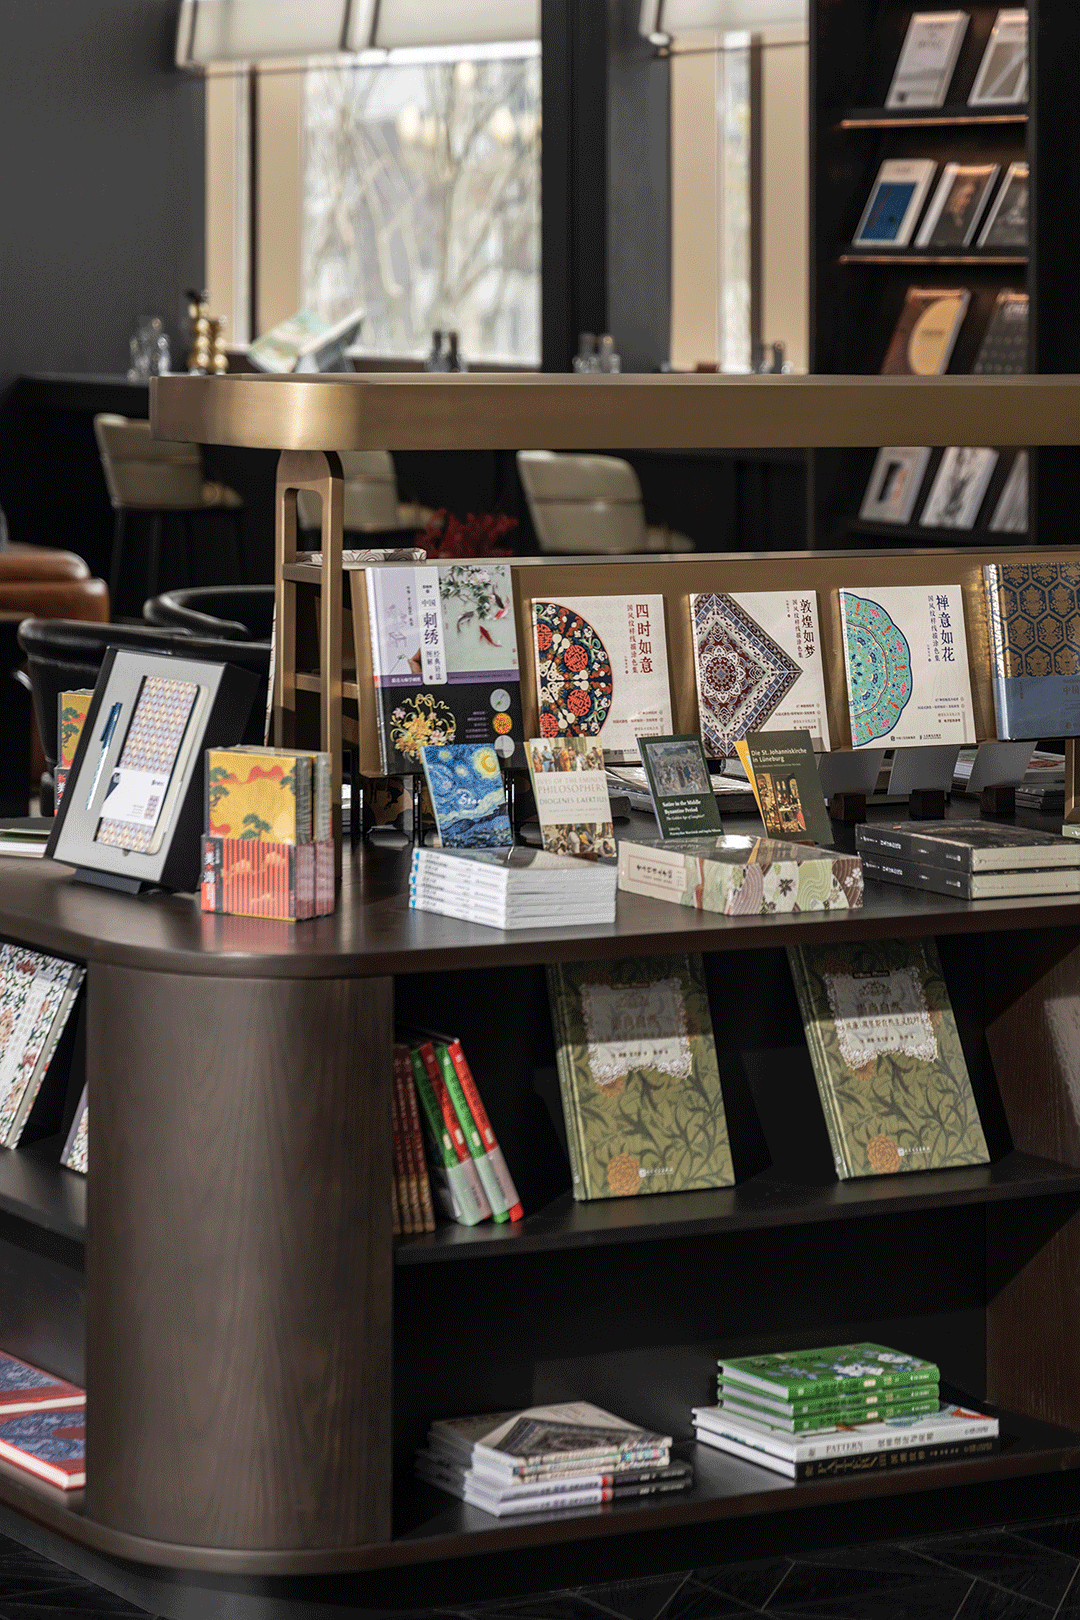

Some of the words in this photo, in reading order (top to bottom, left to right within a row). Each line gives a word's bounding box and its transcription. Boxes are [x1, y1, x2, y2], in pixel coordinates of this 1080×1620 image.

[421, 599, 437, 607] 中国
[423, 612, 439, 645] 刺绣
[799, 598, 815, 659] 敦煌如梦
[936, 594, 955, 663] 禅意如花
[636, 603, 653, 674] 四时如意
[769, 747, 807, 755] Johanniskirche
[537, 783, 606, 794] PHILOSOPHERS
[539, 797, 575, 805] DIOGENES
[826, 1441, 864, 1453] PATTERN
